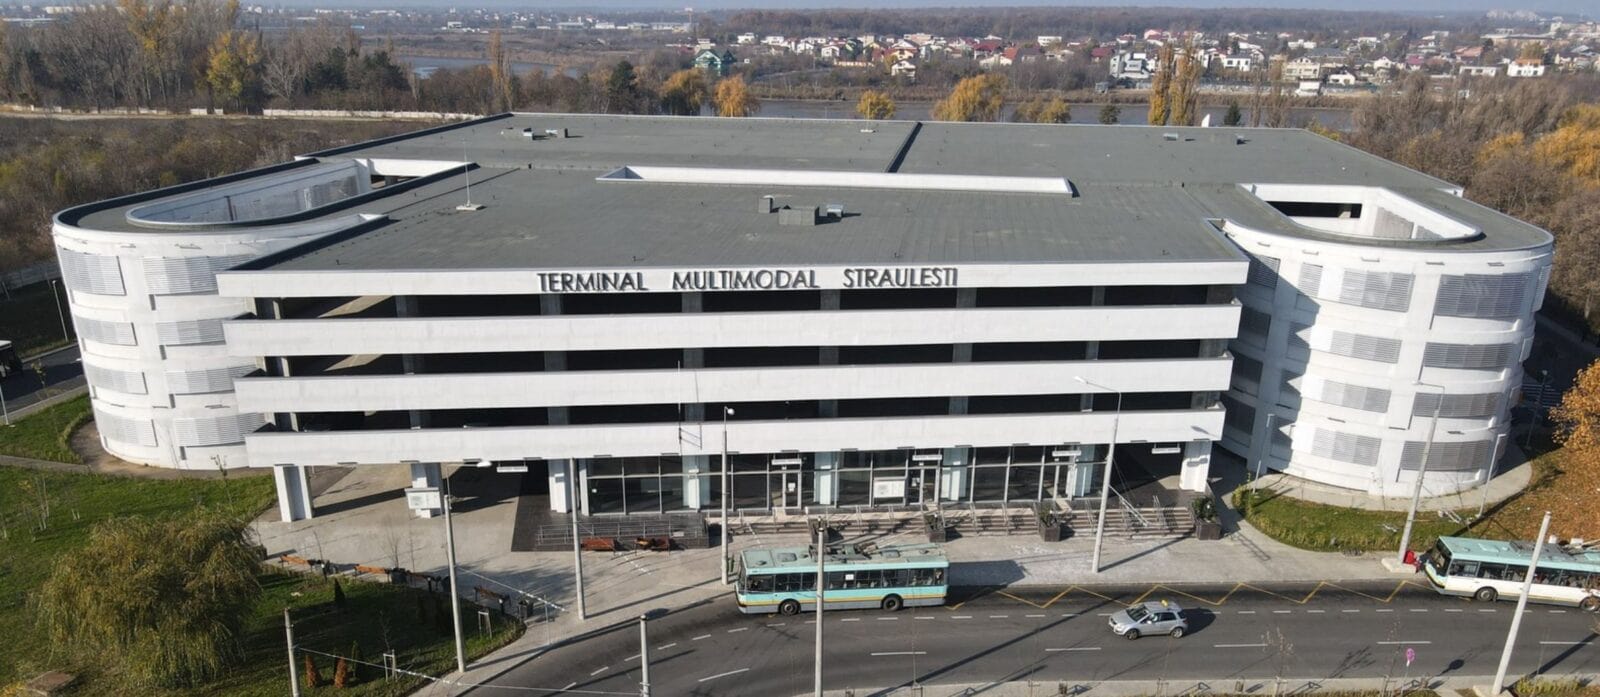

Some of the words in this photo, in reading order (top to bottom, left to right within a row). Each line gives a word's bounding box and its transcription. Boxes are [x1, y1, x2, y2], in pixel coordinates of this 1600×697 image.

[537, 272, 649, 292] TERMINAL
[672, 269, 821, 290] MULTIMODAL
[843, 267, 958, 288] STRAULESTI
